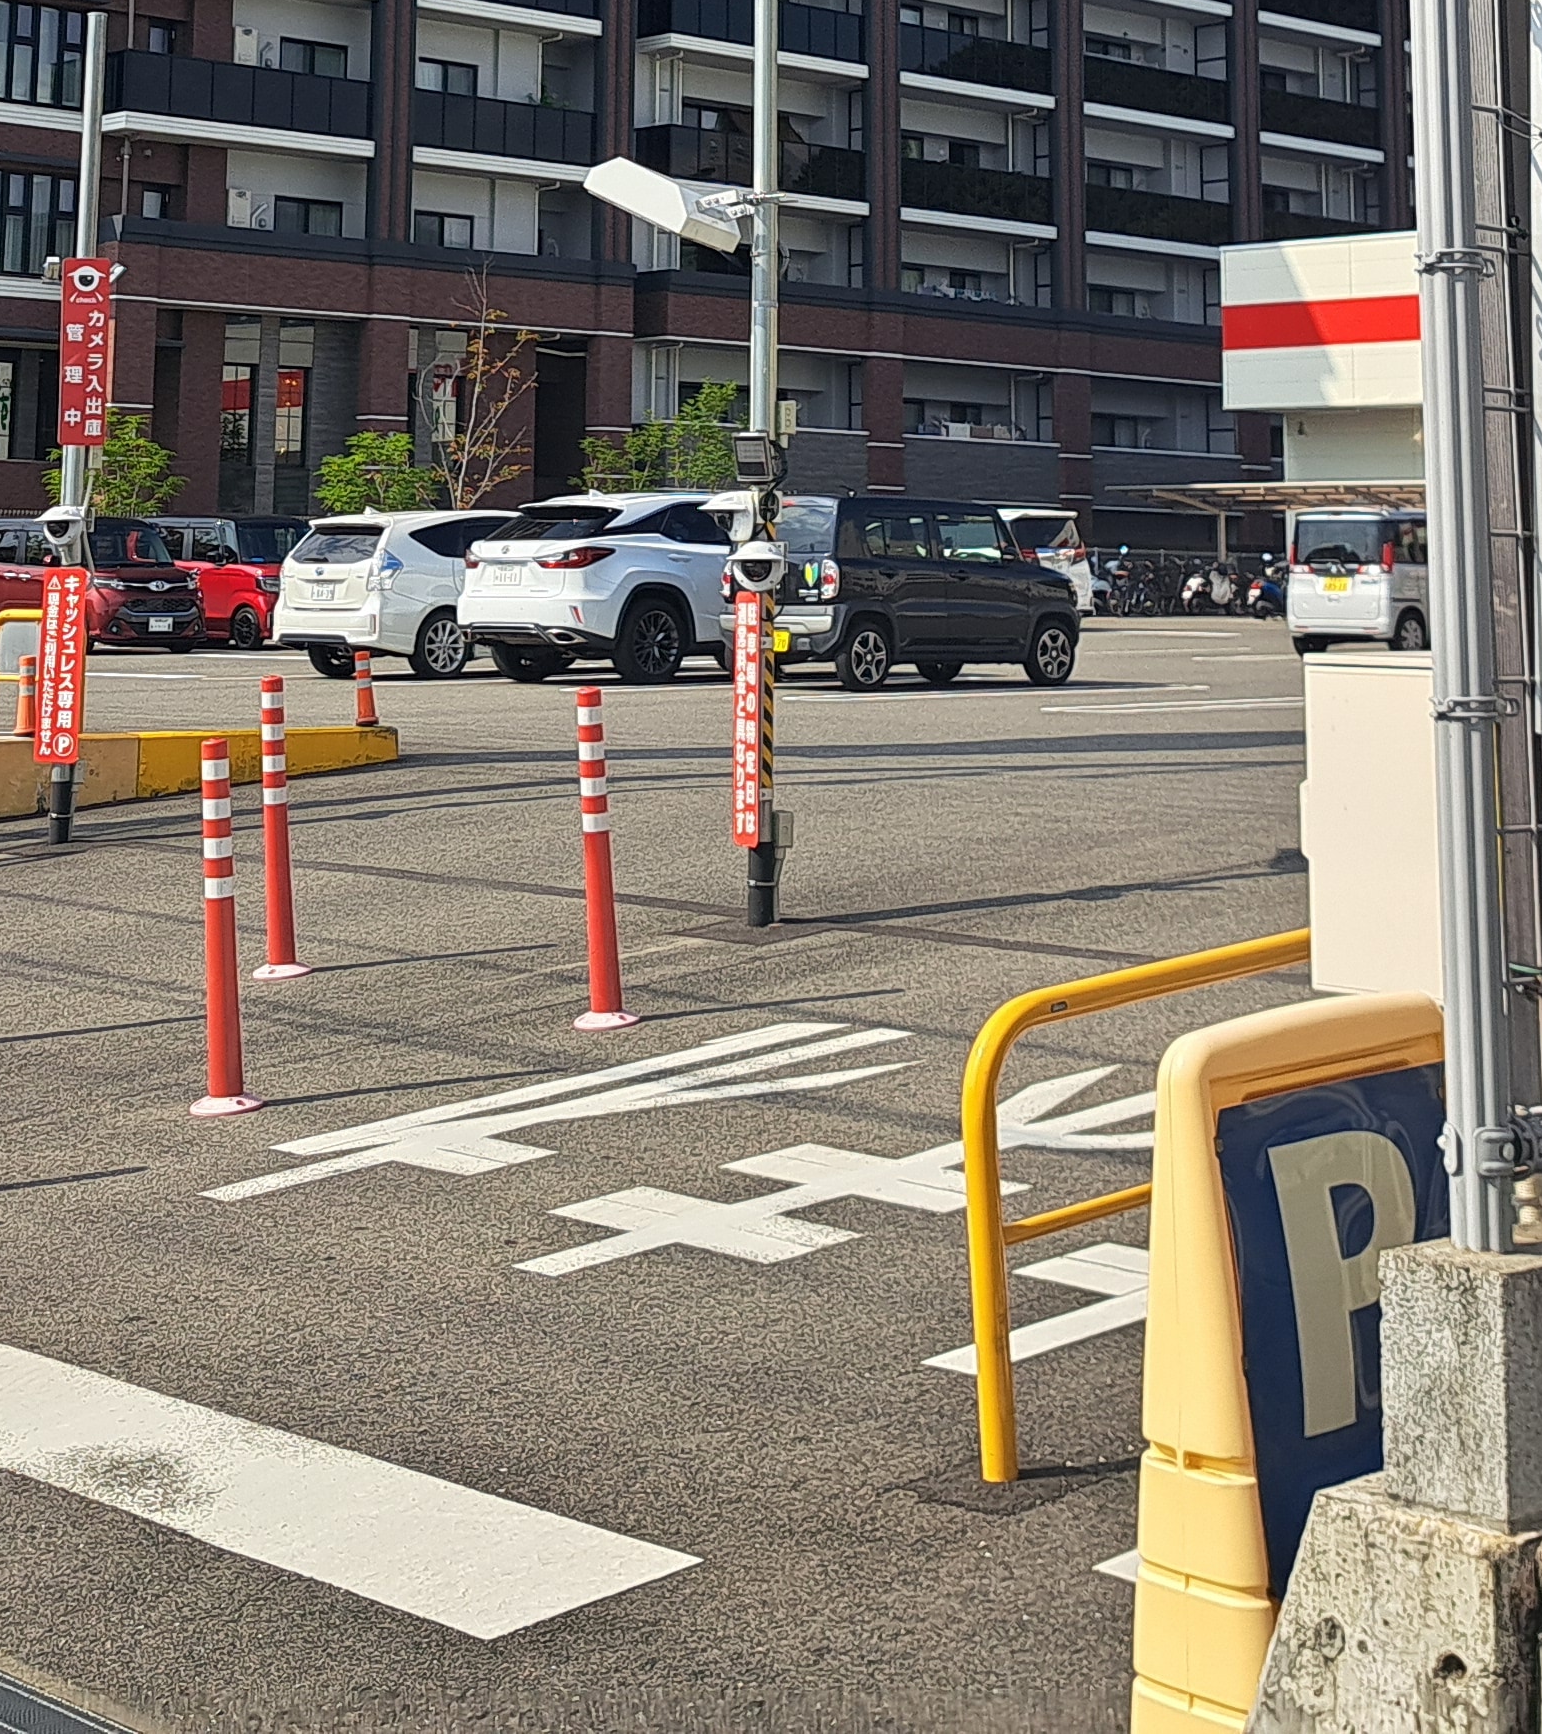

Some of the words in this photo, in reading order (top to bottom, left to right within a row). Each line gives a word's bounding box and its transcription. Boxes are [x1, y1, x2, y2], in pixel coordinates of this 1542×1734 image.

[63, 323, 85, 427] 管理中
[84, 310, 106, 437] カメラ入出庫
[56, 575, 80, 729] キャッシュレス専用
[1267, 1130, 1417, 1440] P
